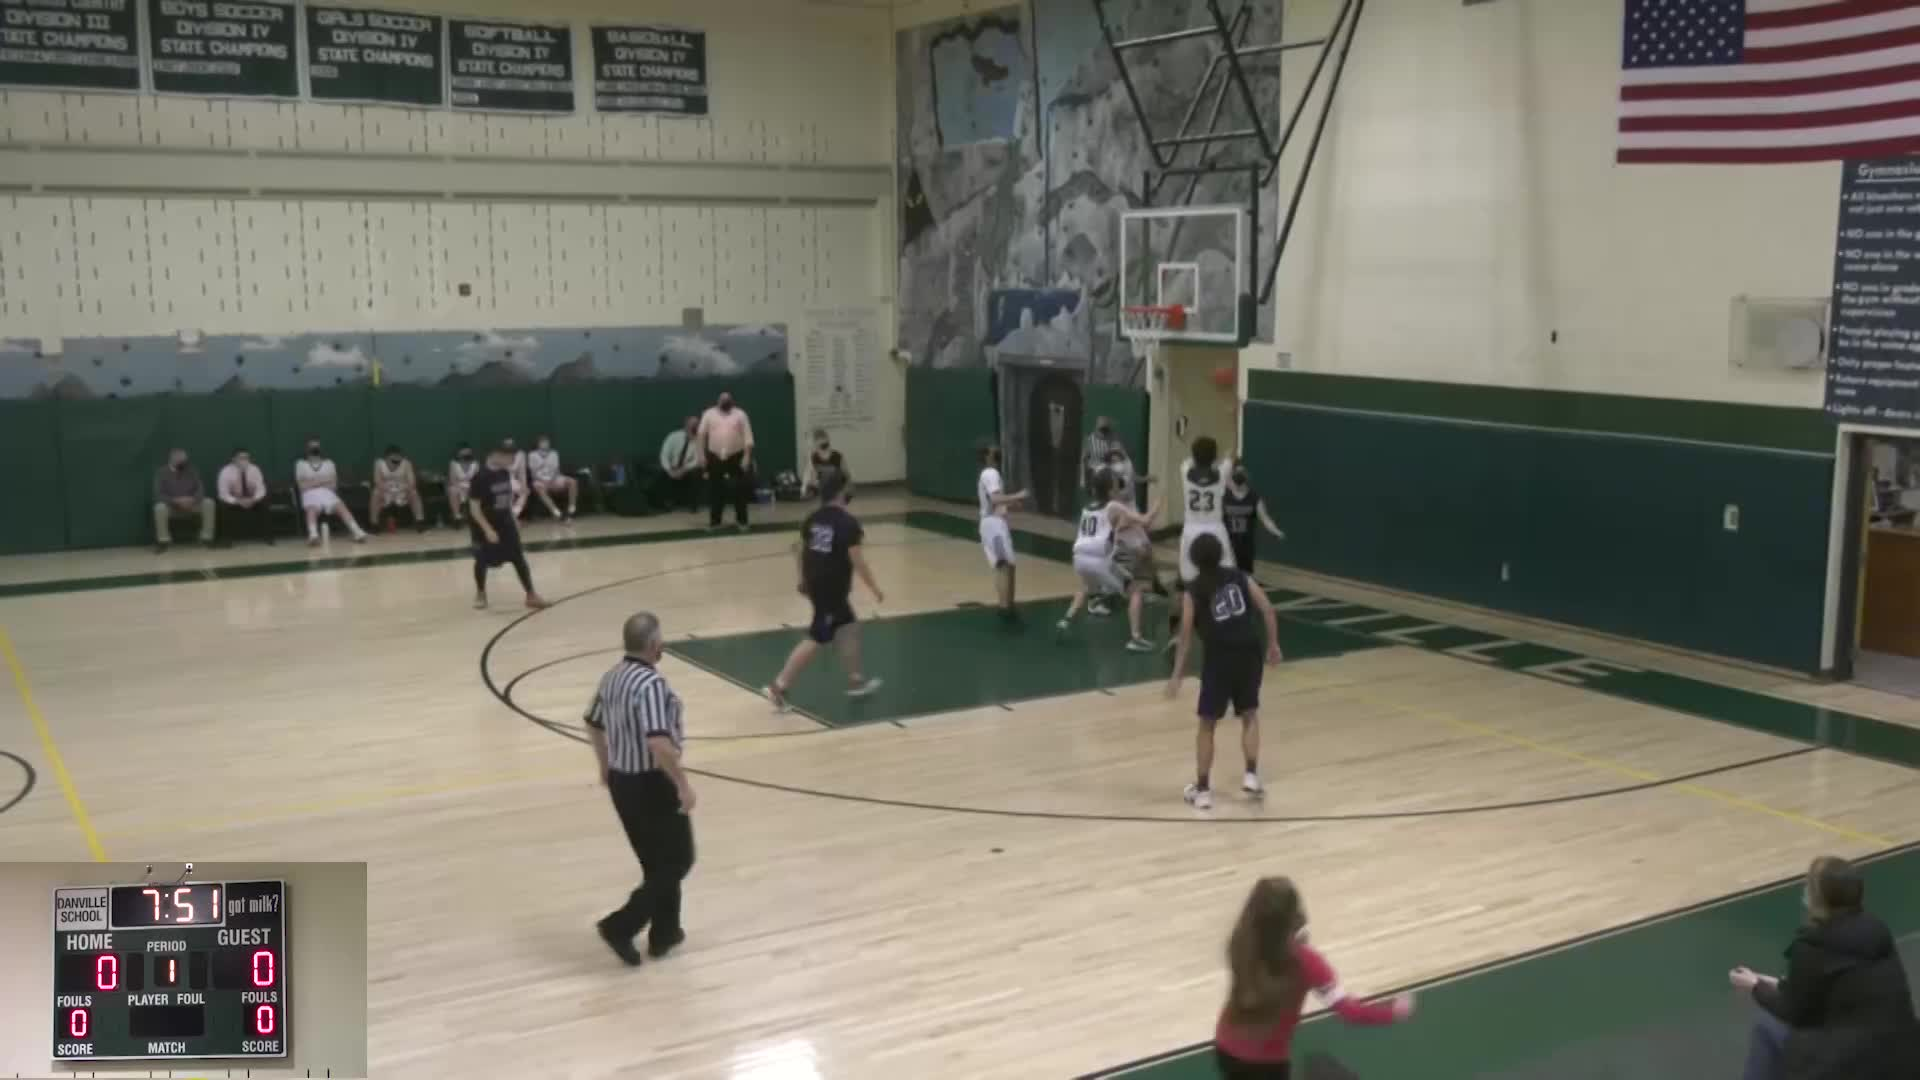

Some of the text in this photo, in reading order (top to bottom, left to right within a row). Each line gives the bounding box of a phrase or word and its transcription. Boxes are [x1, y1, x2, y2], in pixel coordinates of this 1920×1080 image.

[5, 9, 81, 28] DIVISION
[213, 3, 284, 22] SOCCER
[176, 20, 270, 38] DIVISION IV
[368, 13, 432, 32] SOCCER
[0, 28, 128, 51] TATE CHAMPIONS
[332, 29, 418, 49] DIVISION IV
[463, 24, 558, 43] SOFTBALL
[607, 31, 694, 49] BASEBALL
[160, 38, 288, 60] STATE CHAMPIONS
[318, 47, 434, 69] STATE CHAMPIONS
[472, 41, 531, 59] DIVISION
[615, 47, 669, 63] DIVISION
[457, 58, 566, 79] STATE CHAMPIONS
[602, 64, 699, 82] STATE CHAMPIONS
[1846, 228, 1864, 239] NO
[1844, 248, 1862, 259] NO
[1842, 282, 1858, 292] NO
[1188, 489, 1215, 512] 23
[1081, 515, 1098, 537] 40
[57, 896, 107, 910] DANVILLE
[143, 887, 219, 923] 7:51
[227, 896, 279, 917] got milk?
[60, 910, 103, 923] SCHOOL
[66, 934, 113, 951] HOME
[146, 940, 187, 952] PERIOD
[217, 928, 271, 946] GUEST
[96, 955, 117, 991] 0
[168, 959, 176, 983] 1
[253, 951, 275, 987] 0
[57, 995, 92, 1008] FOULS
[127, 992, 206, 1007] PLAYER FOUL
[241, 991, 278, 1004] FOULS
[70, 1009, 88, 1037] 0
[256, 1005, 274, 1034] 0
[57, 1043, 93, 1056] SCORE
[147, 1041, 186, 1055] MATCH
[242, 1040, 279, 1053] SCORE
